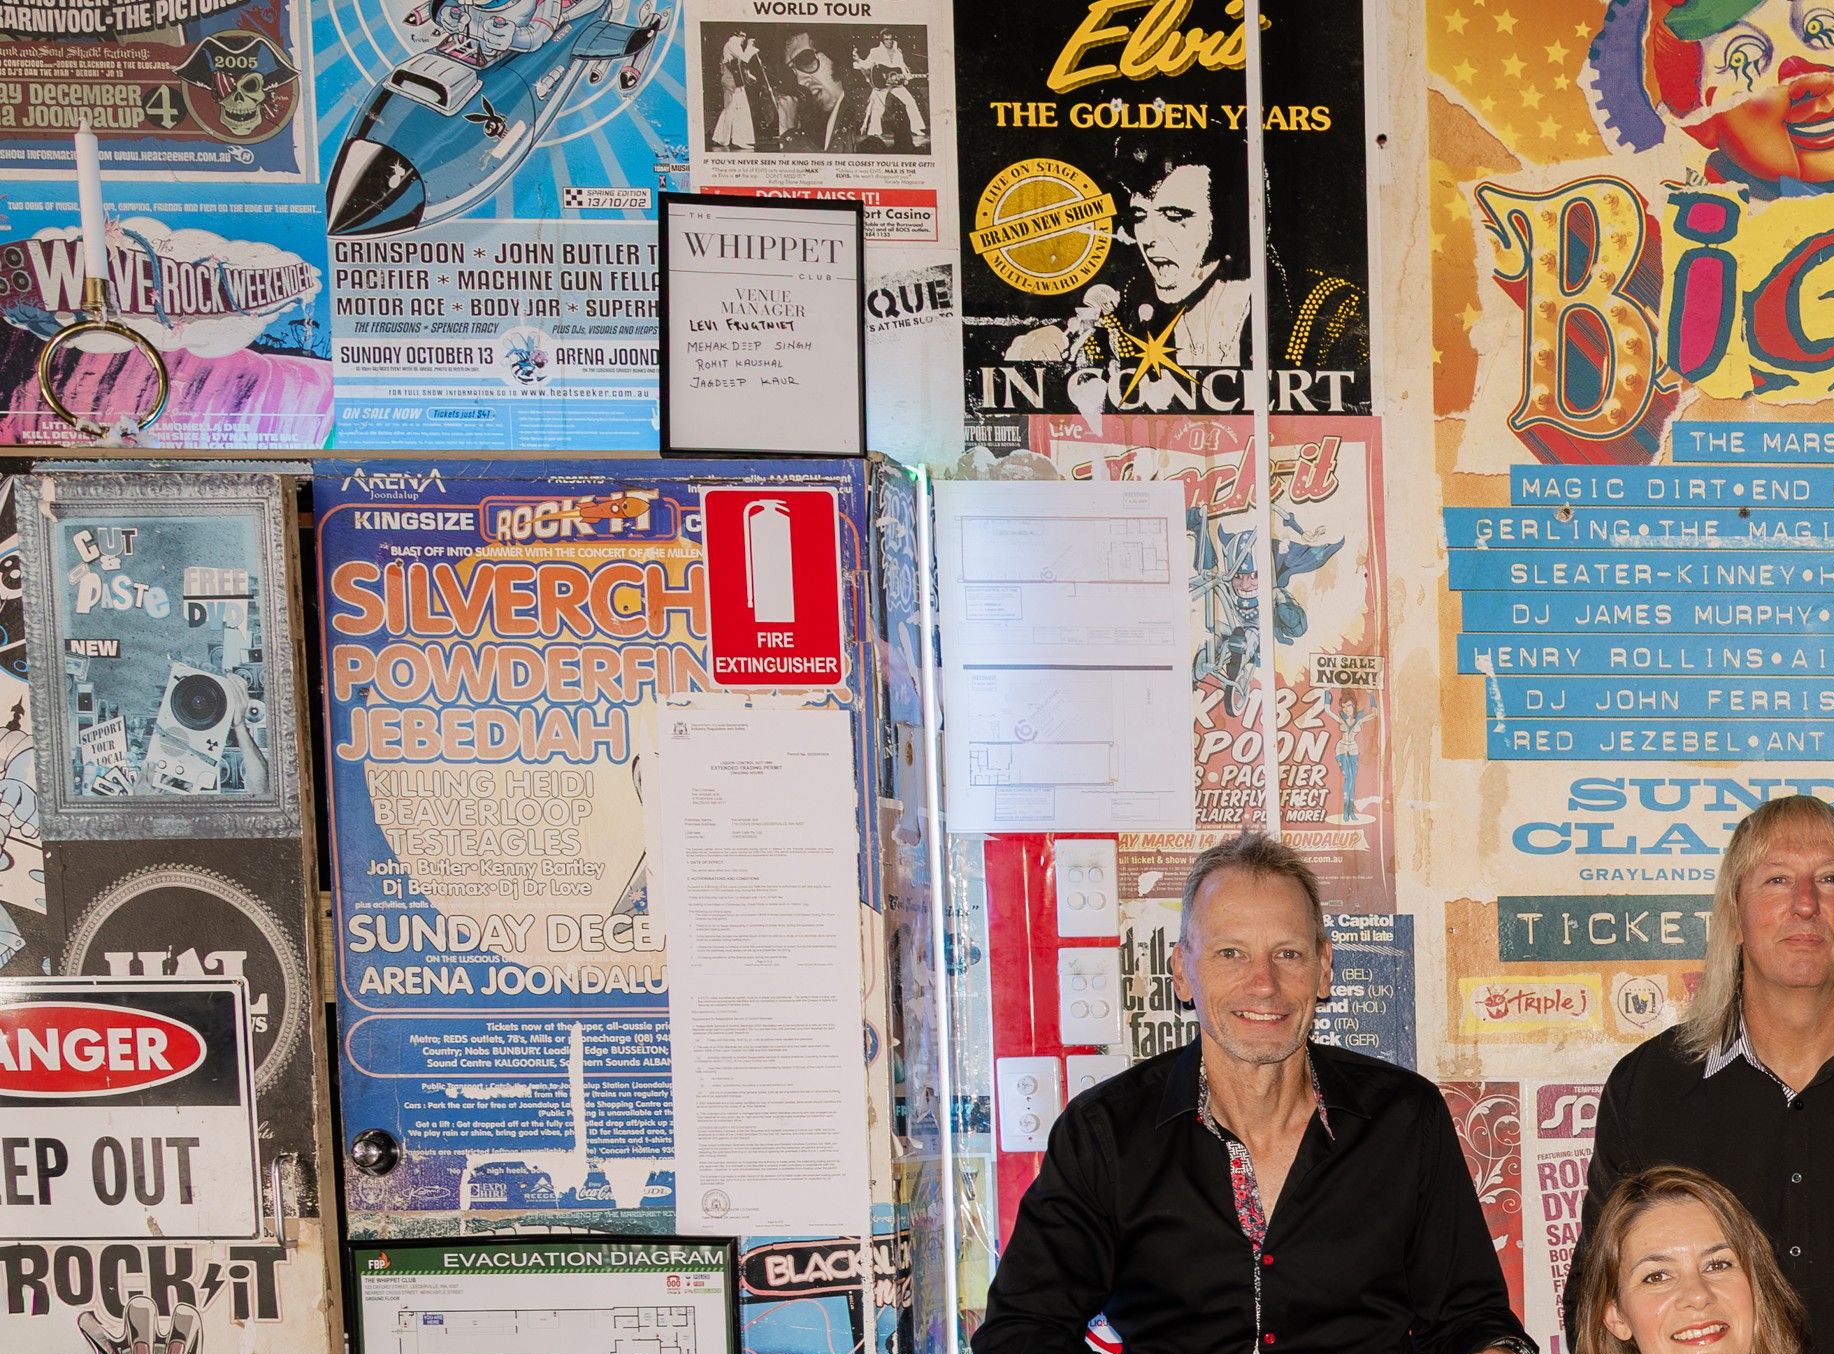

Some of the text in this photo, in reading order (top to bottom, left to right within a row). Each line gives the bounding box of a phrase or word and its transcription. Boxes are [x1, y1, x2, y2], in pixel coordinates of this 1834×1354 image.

[754, 2, 872, 16] WORLD TOUR
[215, 56, 258, 69] 2005
[990, 102, 1057, 127] THE
[1070, 103, 1208, 129] GOLDEN
[618, 189, 648, 197] EDITION
[587, 197, 646, 208] 13/10/02
[886, 209, 931, 220] Casino
[979, 198, 1105, 249] BRAND NEW SHOW
[335, 242, 640, 265] GRINSPOON JOHN BUTLER
[682, 232, 844, 264] WHIPPET
[163, 259, 314, 315] ROCK WEEKENDER
[458, 270, 603, 291] MACHINE GUN
[735, 288, 792, 303] VENUE
[337, 298, 445, 316] MOTOR ACE
[722, 301, 805, 317] MANAGER
[355, 321, 499, 334] THE FERGUSONS SPENCER TRACY
[689, 320, 718, 332] LEVI
[775, 341, 812, 351] SINGH
[341, 346, 604, 366] SUNDAY OCTOBER 13 ARENA
[696, 359, 728, 371] ROHIT
[761, 376, 800, 386] KAUR
[979, 366, 1045, 409] IN
[521, 388, 649, 398] www.heatseeker.com.au
[433, 409, 459, 418] Tickets
[1691, 432, 1746, 454] THE
[1522, 477, 1727, 500] MAGIC DIRT
[354, 511, 474, 531] KINGSIZE
[475, 547, 627, 558] SUMMER CONCERT
[186, 568, 247, 595] FREE
[1510, 563, 1796, 586] SLEATER-KINNEY
[1575, 604, 1810, 626] JAMES MURPHY
[70, 640, 118, 657] NEW
[757, 632, 794, 648] FIRE
[716, 656, 838, 674] EXTINGUISHER
[1317, 657, 1375, 669] ON SALE
[1474, 647, 1764, 670] HENRY ROLLINS
[1317, 669, 1378, 685] NOW!
[82, 719, 123, 745] SUPPORT
[336, 706, 628, 762] JEBEDIAH
[367, 769, 595, 799] KILLING HEIDI
[374, 798, 593, 826] BEAVERLOOP
[385, 828, 582, 856] TESTEAGLES
[367, 859, 410, 876] John
[1338, 914, 1394, 929] Capitol
[348, 913, 536, 953] SUNDAY
[1372, 930, 1394, 941] late
[359, 966, 474, 995] ARENA
[91, 1136, 200, 1206] OUT
[368, 1251, 724, 1270] FBP EVACUATION DIAGRAM
